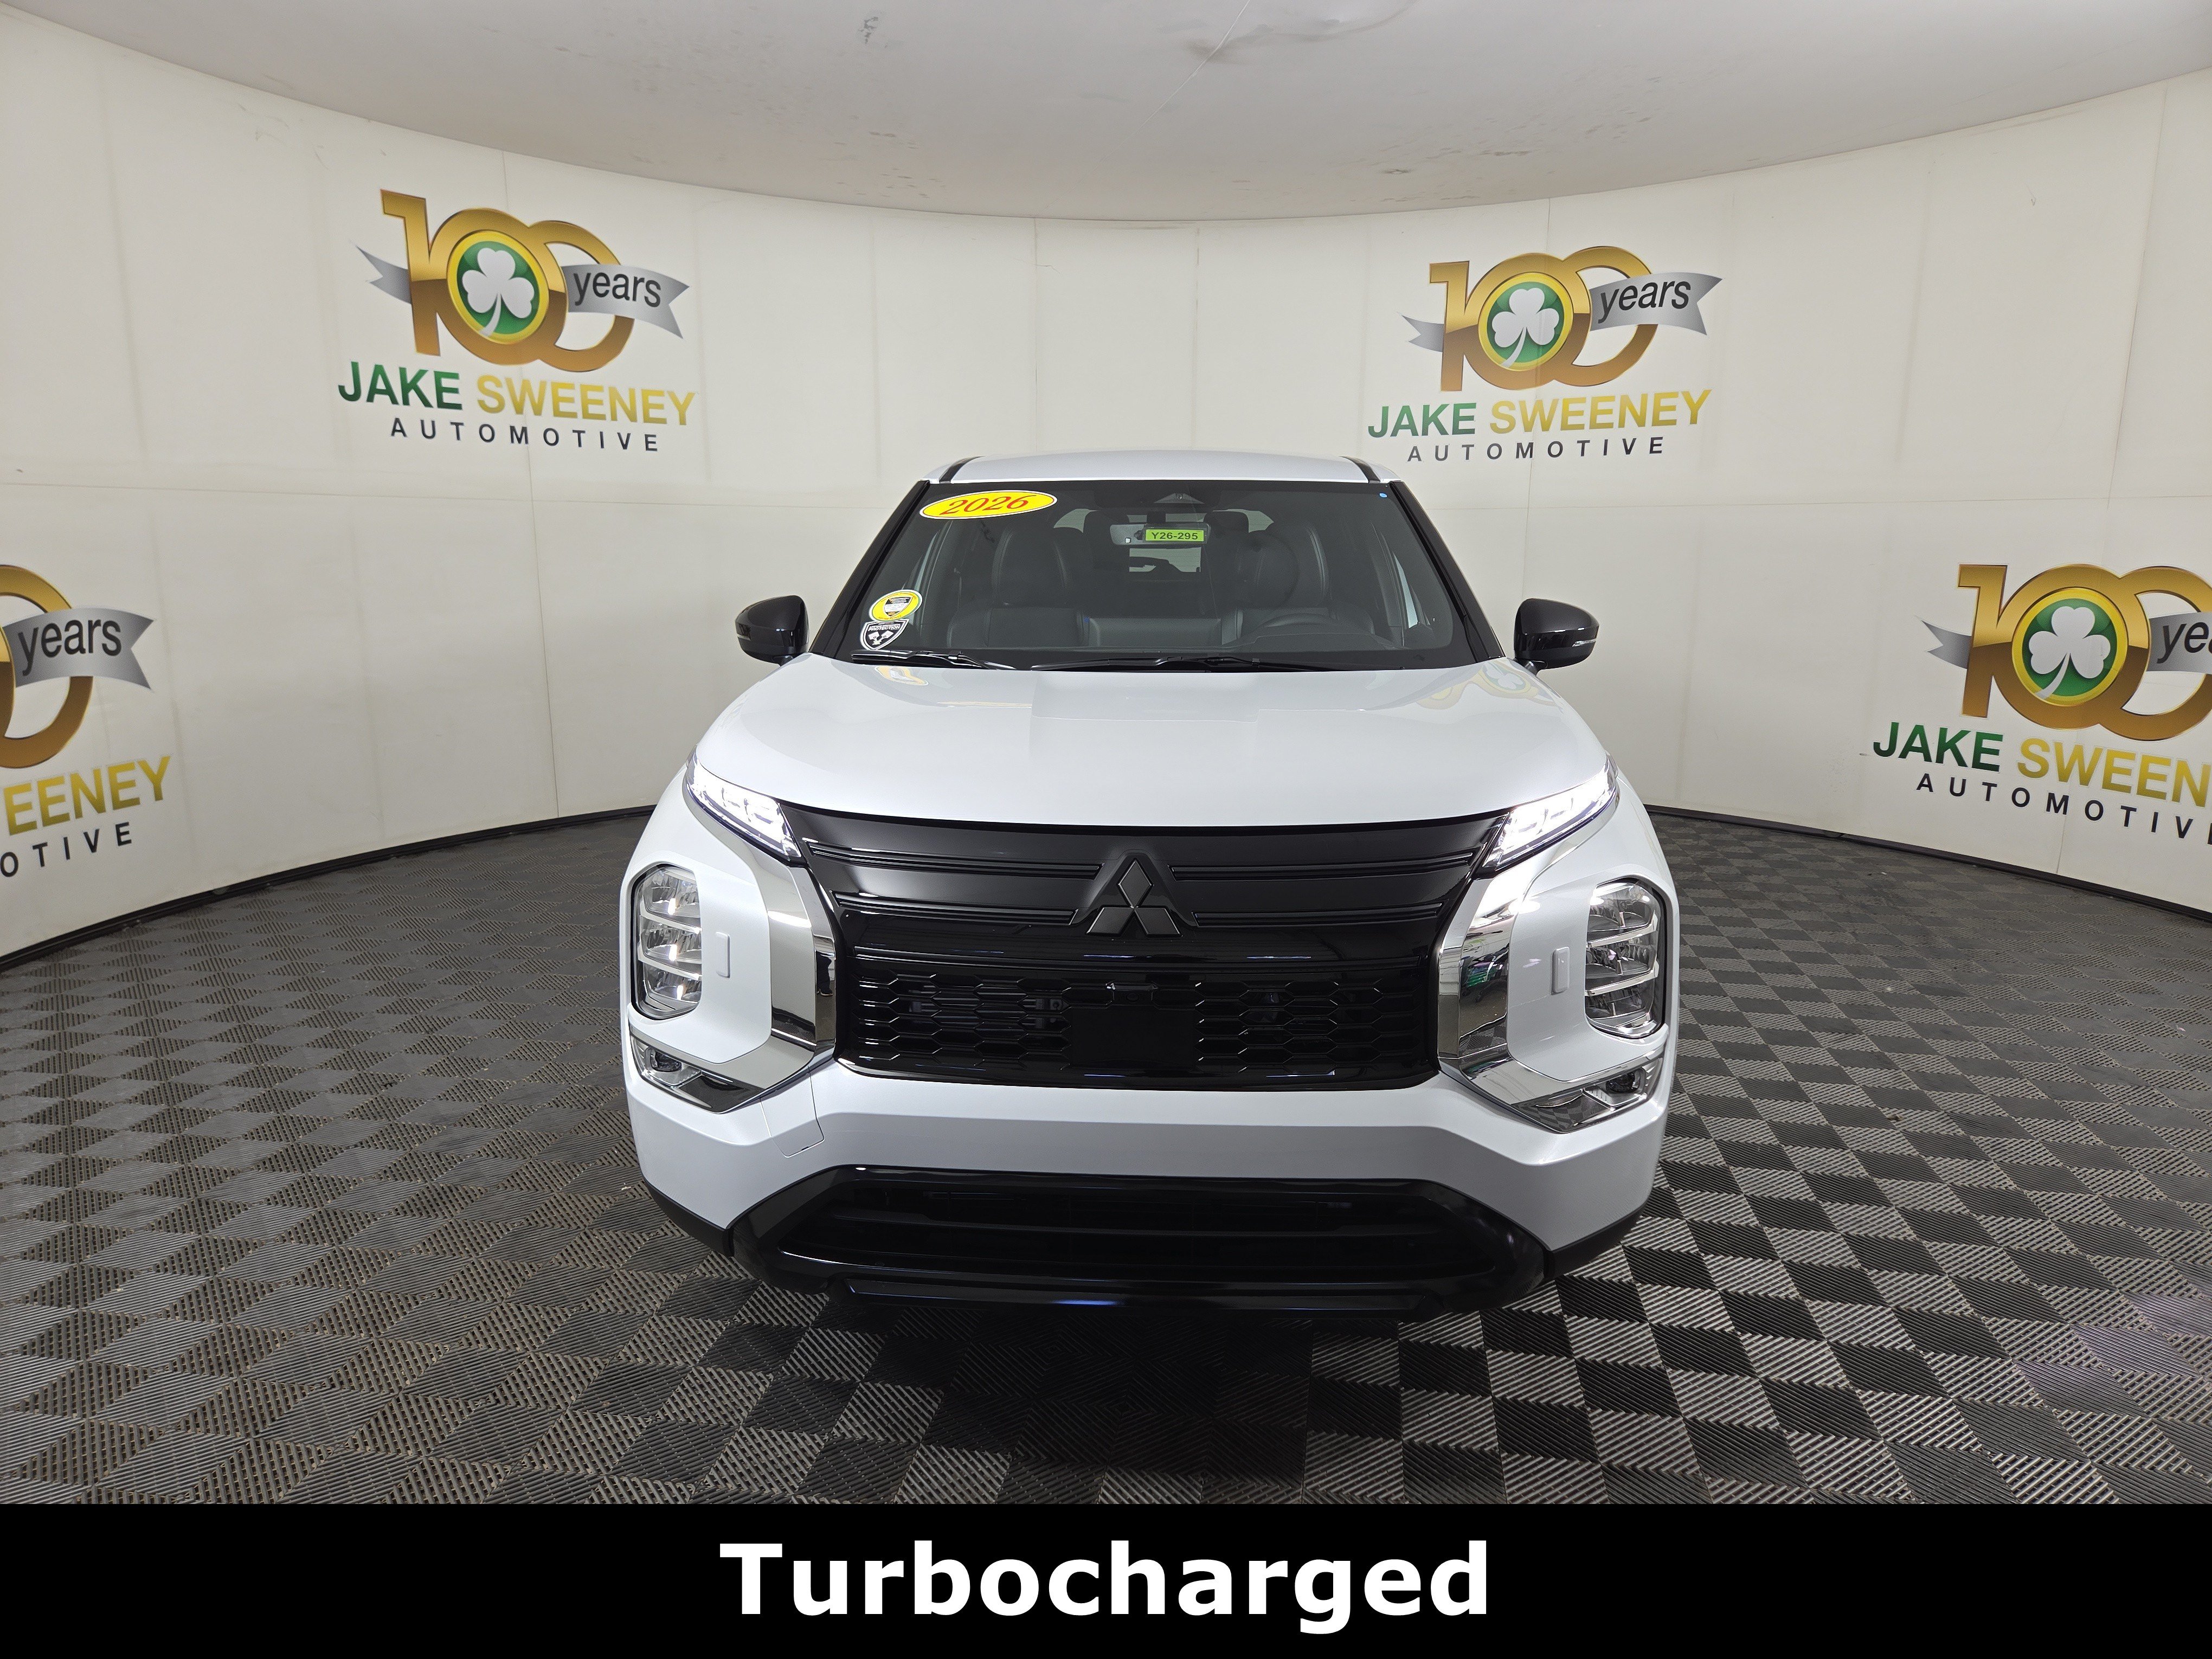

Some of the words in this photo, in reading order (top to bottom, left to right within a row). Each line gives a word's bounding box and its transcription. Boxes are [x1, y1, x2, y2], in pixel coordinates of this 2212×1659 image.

[573, 270, 661, 307] years
[1598, 280, 1691, 324] years
[338, 361, 463, 410] JAKE
[477, 374, 696, 426] SWEENEY
[1368, 402, 1477, 438] JAKE
[1489, 389, 1712, 433] SWEENEY
[390, 417, 658, 452] AUTOMOTIVE
[1407, 436, 1664, 462] AUTOMOTIVE
[939, 495, 1037, 516] 2026
[1151, 532, 1198, 540] Y26-295
[18, 619, 122, 676] years
[1873, 722, 2004, 773] JAKE
[2017, 738, 2211, 808] SWEEN
[3, 756, 171, 835] EENEY
[1916, 773, 2212, 845] AUTOMOTIV
[0, 822, 132, 877] OTIVE
